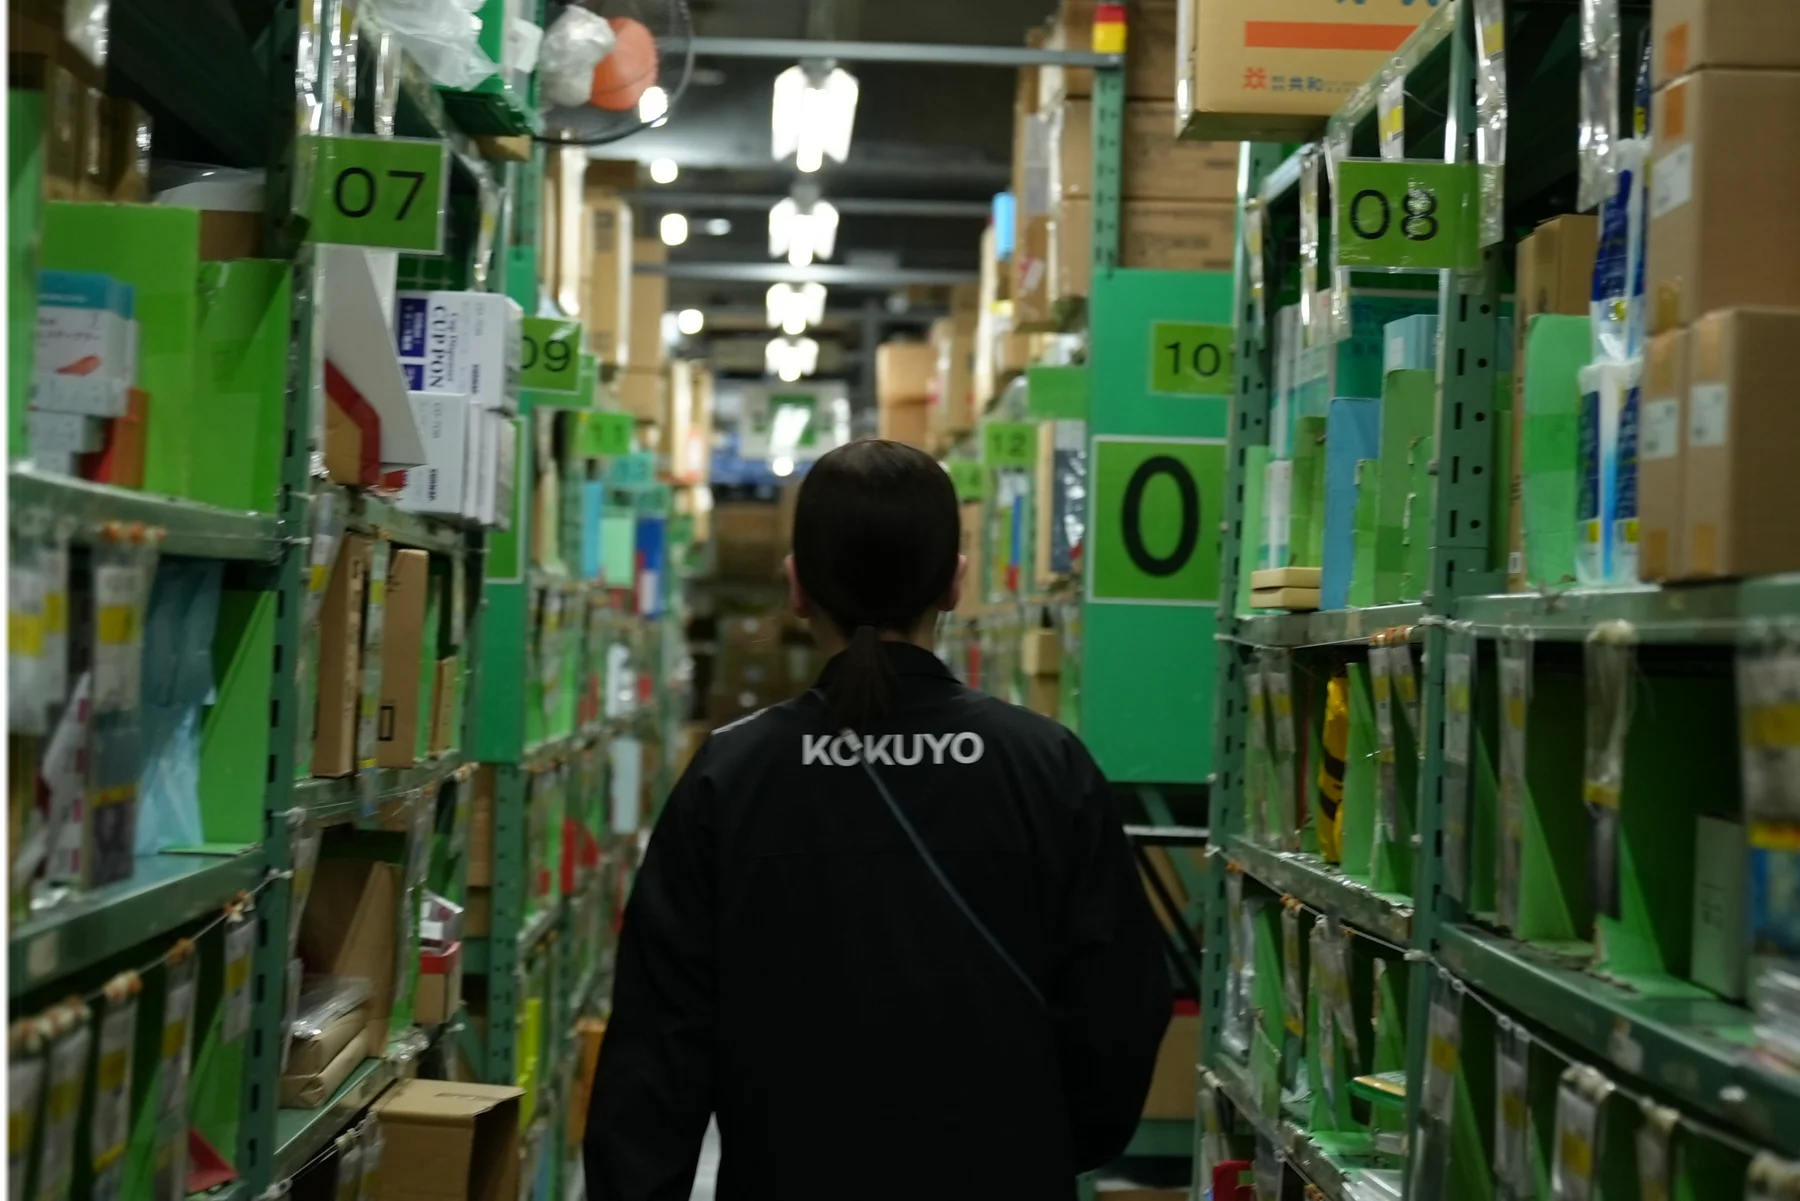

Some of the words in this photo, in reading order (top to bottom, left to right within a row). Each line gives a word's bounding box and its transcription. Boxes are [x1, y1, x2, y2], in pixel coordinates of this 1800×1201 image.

[1288, 76, 1323, 92] 共和
[333, 166, 426, 221] 07
[1350, 188, 1438, 241] 08
[1164, 340, 1222, 377] 10
[992, 431, 1027, 458] 12
[1121, 455, 1199, 577] 0
[801, 731, 985, 767] KOKUYO
